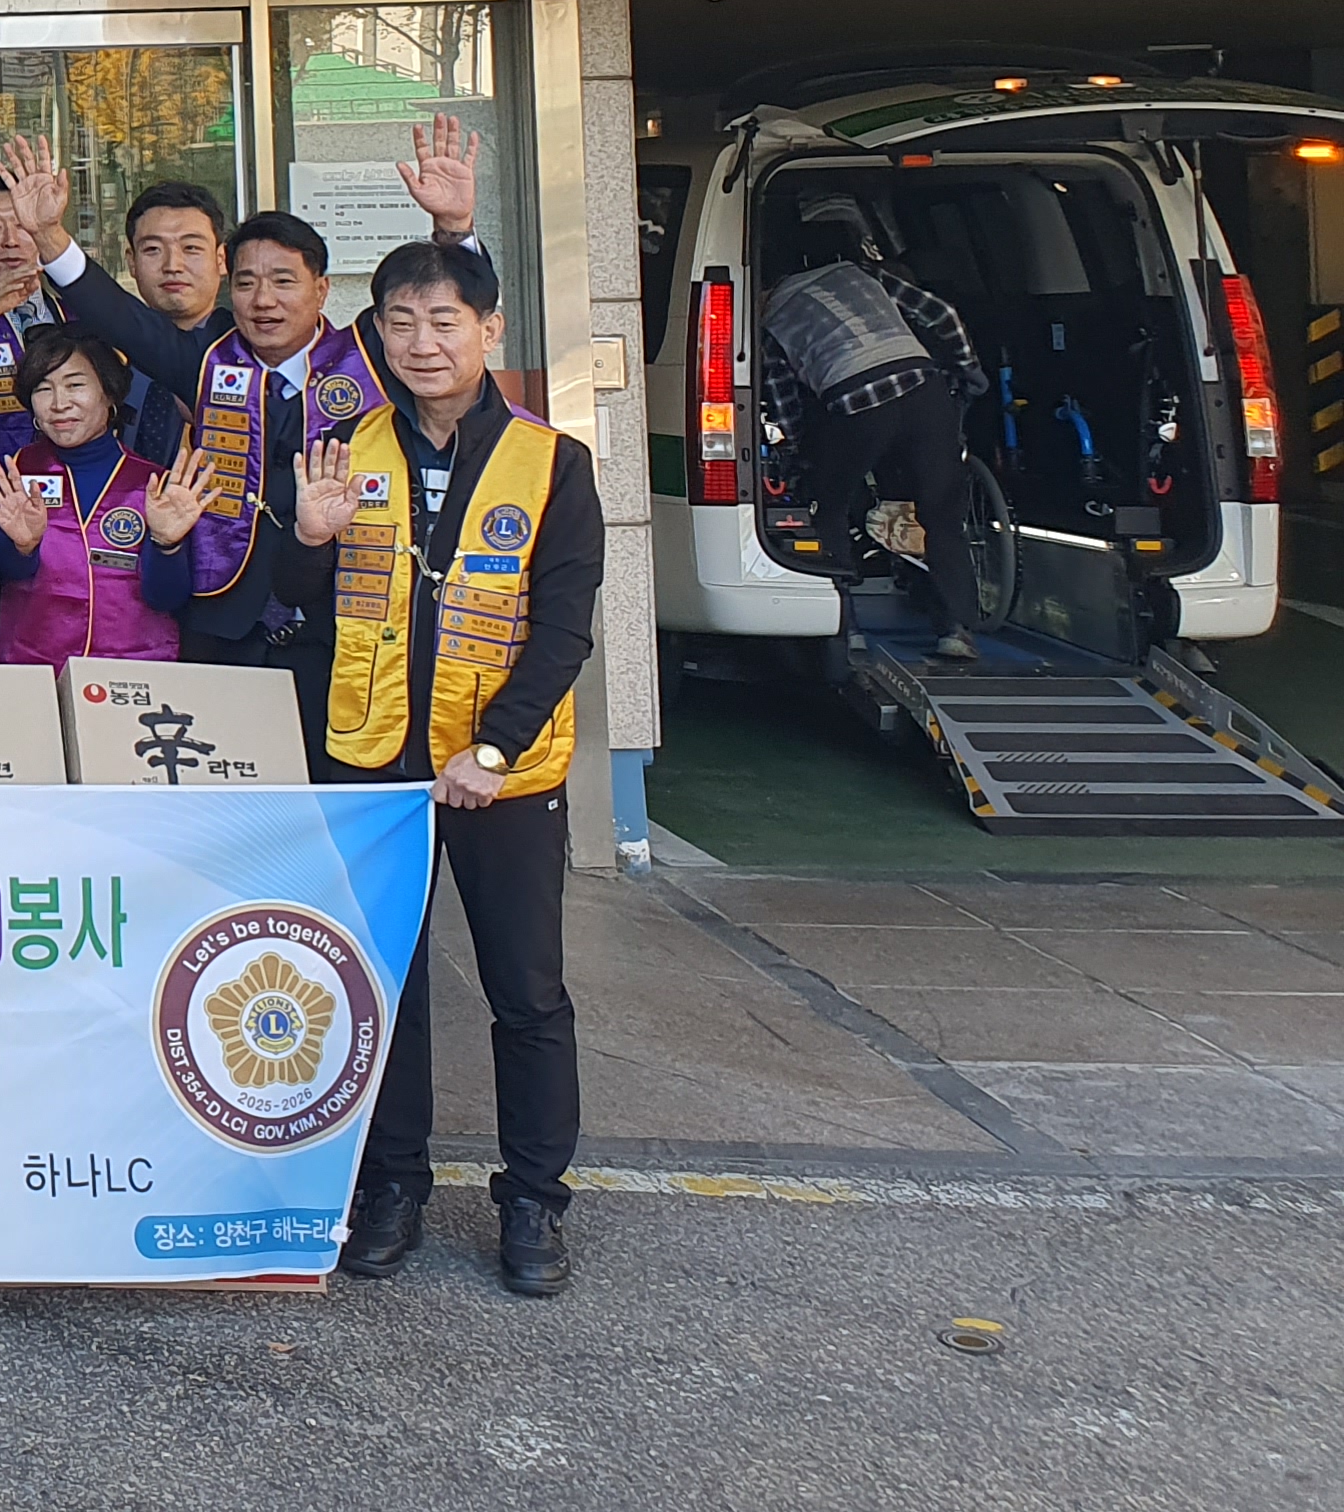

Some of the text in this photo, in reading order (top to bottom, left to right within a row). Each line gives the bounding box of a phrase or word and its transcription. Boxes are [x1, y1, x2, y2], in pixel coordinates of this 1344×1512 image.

[215, 394, 243, 402] KOREA
[110, 689, 152, 706] 농심
[135, 704, 215, 785] 辛
[207, 759, 258, 779] 라면
[182, 916, 349, 973] Let's be together
[256, 998, 291, 1013] LIONS
[268, 1013, 284, 1035] L
[237, 1087, 313, 1113] 2025-2026
[220, 1111, 249, 1135] LCI
[23, 1151, 154, 1196] 하나LC
[153, 1217, 342, 1251] 장소: 양천구 해누리
